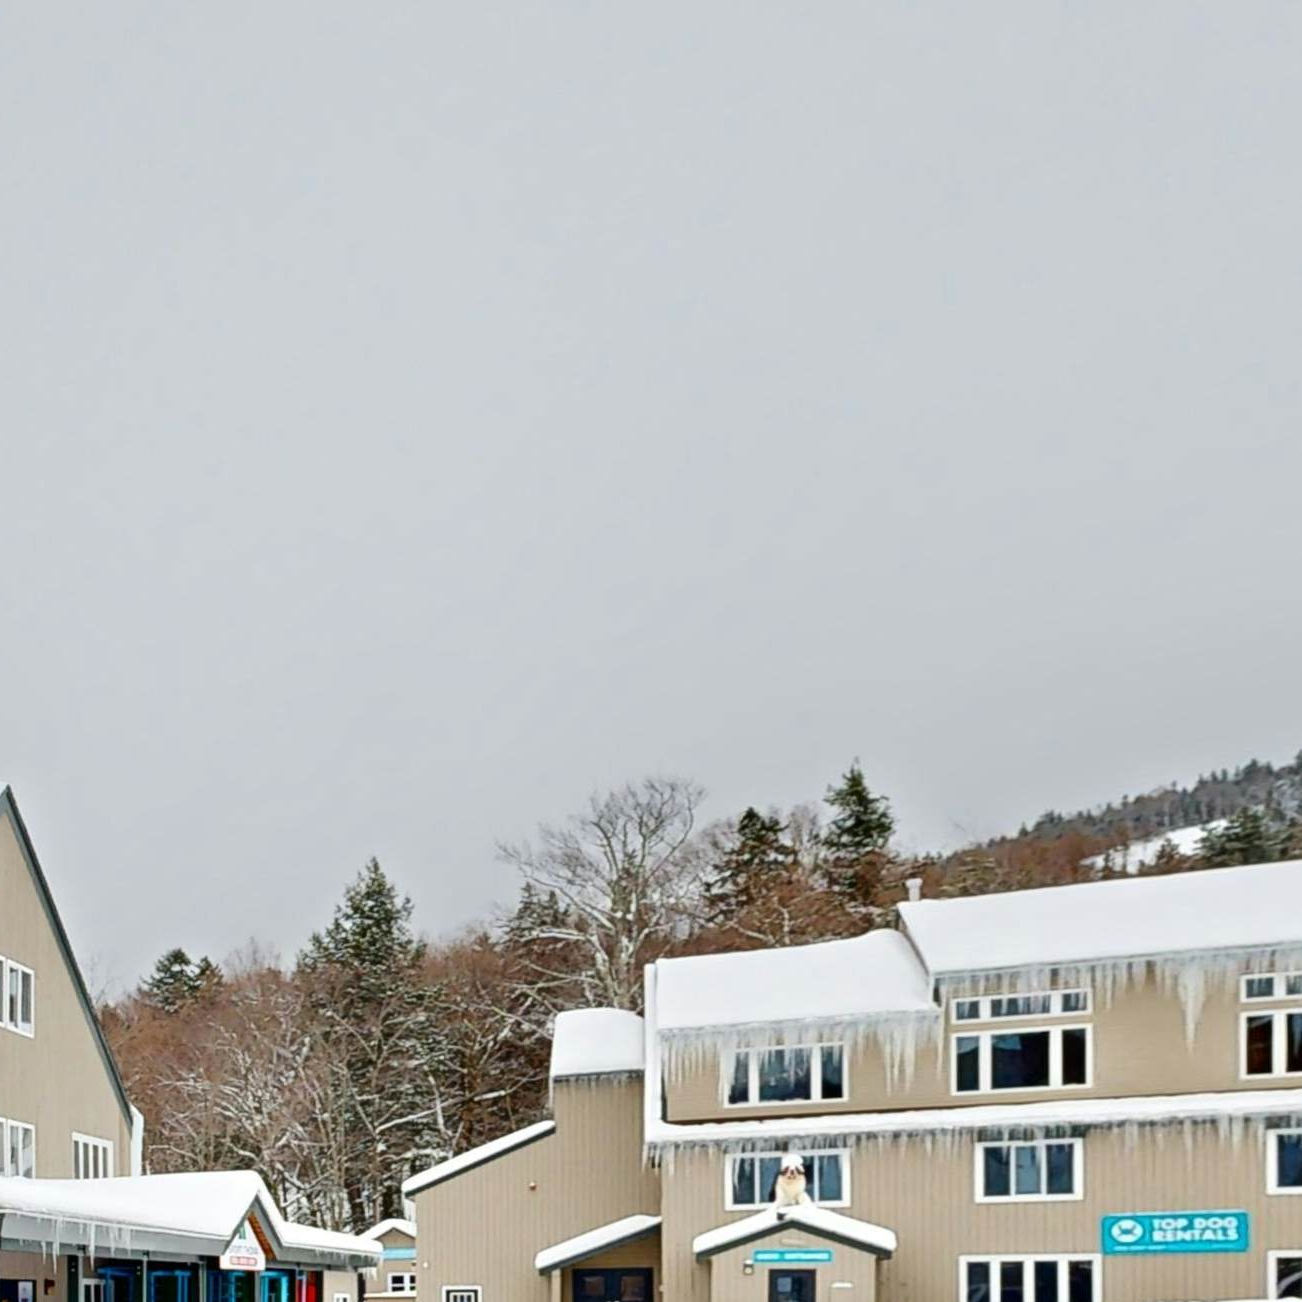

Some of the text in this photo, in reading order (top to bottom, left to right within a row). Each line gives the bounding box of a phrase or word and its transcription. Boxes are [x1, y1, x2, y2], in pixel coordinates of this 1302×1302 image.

[1153, 1216, 1238, 1230] TOP DOG
[1152, 1229, 1239, 1242] RENTALS
